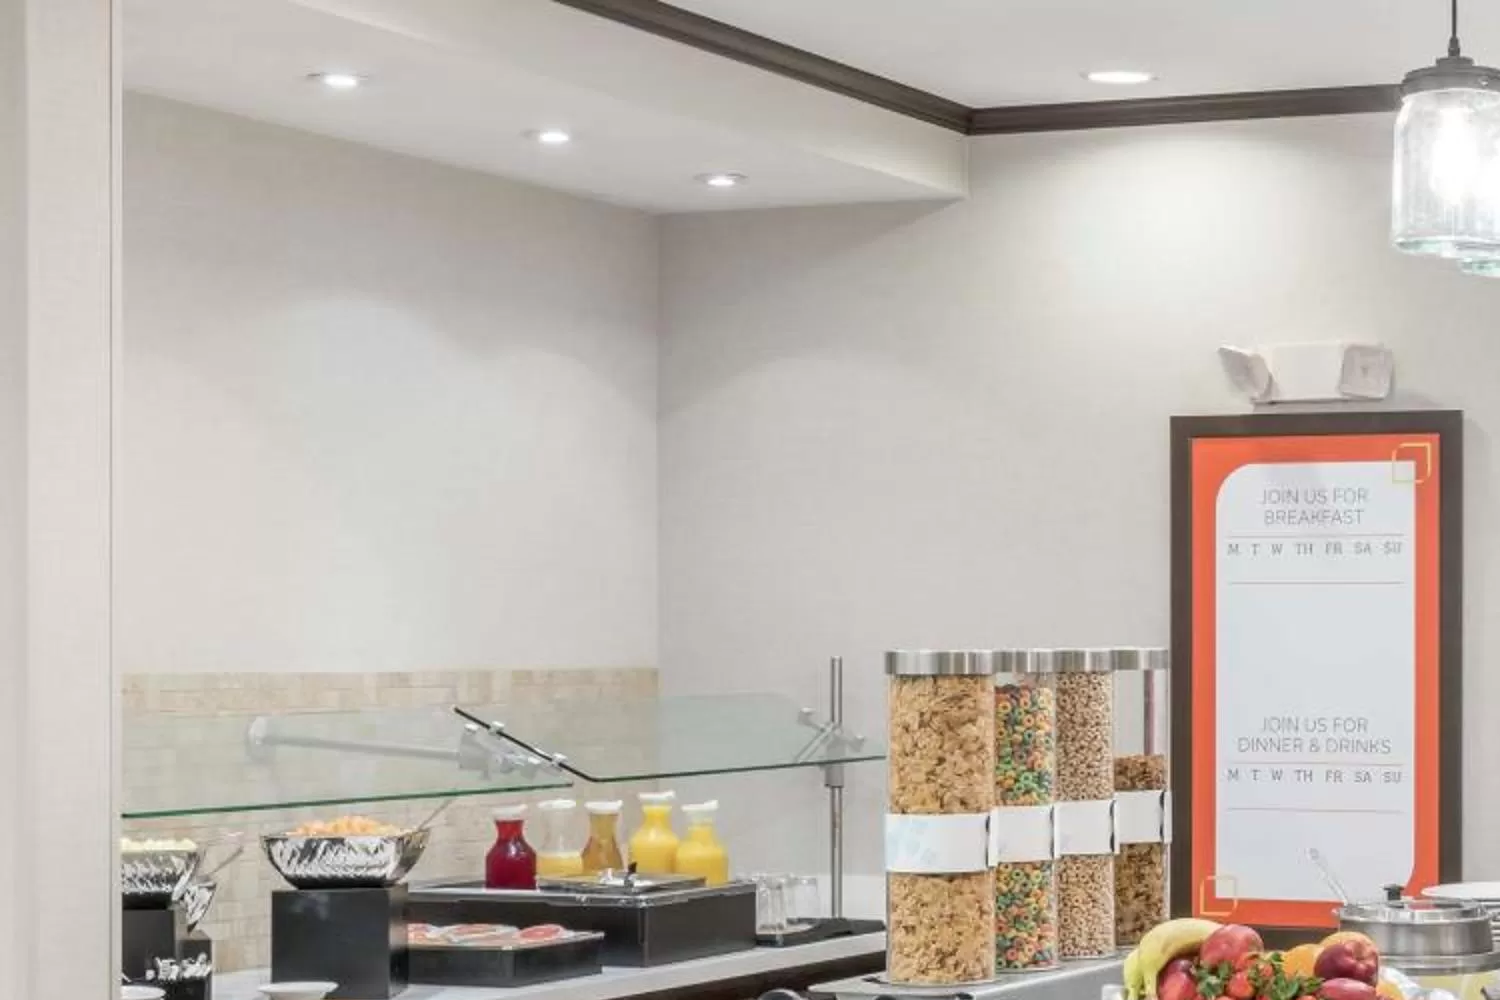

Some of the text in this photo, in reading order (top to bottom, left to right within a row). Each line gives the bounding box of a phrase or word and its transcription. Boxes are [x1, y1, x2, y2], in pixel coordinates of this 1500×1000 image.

[1261, 487, 1368, 504] JOIN US FOR
[1263, 509, 1365, 525] BREAKFAST
[1227, 541, 1402, 556] M T W TH FR SA SU
[1262, 716, 1368, 733] JOIN US FOR
[1237, 737, 1392, 754] DINNER & DRINKS
[1227, 768, 1402, 783] M T W TH FR SA SU
